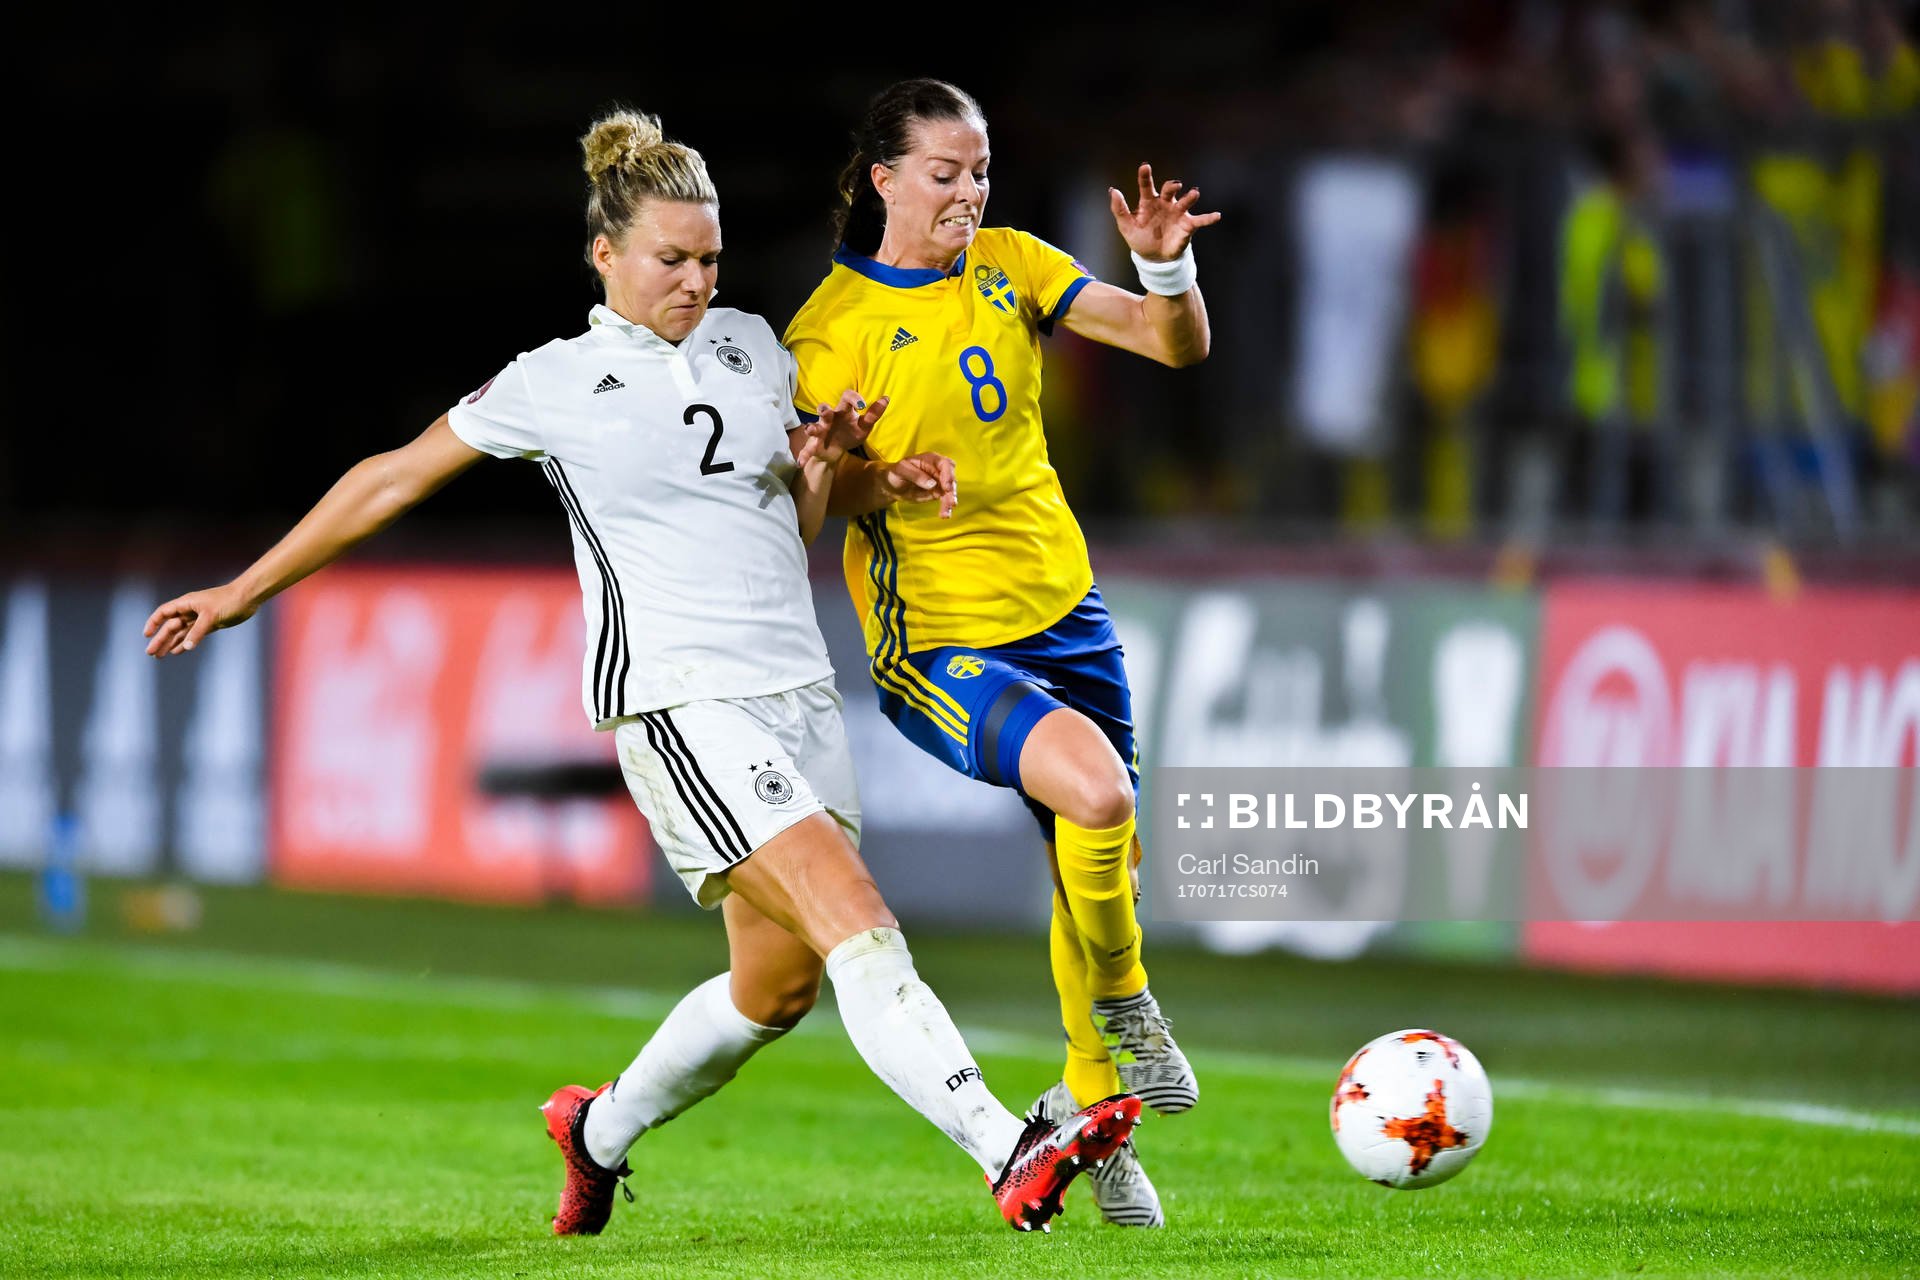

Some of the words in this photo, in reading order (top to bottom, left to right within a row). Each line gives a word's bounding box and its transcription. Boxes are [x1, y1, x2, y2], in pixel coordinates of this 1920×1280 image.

[889, 335, 918, 351] adidas
[593, 382, 626, 394] adidas
[959, 345, 1008, 423] 8
[683, 404, 735, 476] 2
